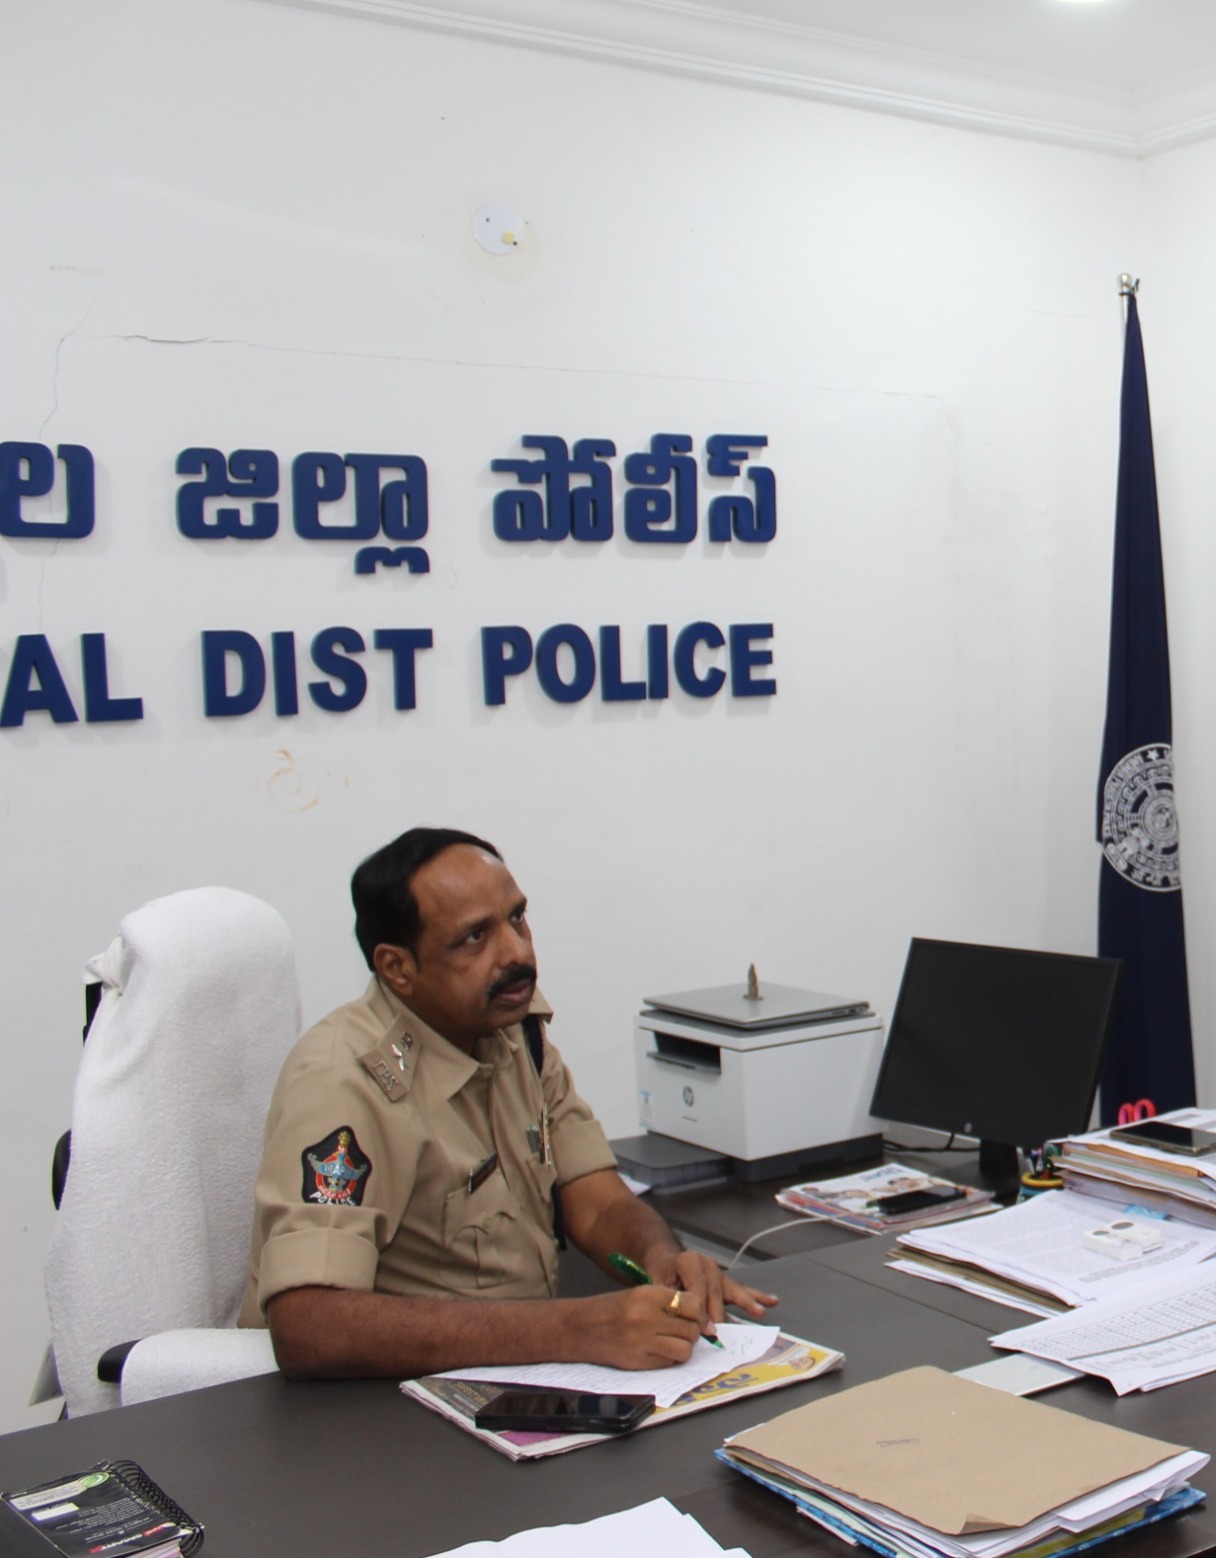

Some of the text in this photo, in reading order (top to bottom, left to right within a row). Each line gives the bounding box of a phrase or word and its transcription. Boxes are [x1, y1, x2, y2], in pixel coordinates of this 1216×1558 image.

[174, 446, 431, 575] జిల్లా
[200, 626, 434, 718] DIST
[480, 621, 777, 706] POLICE
